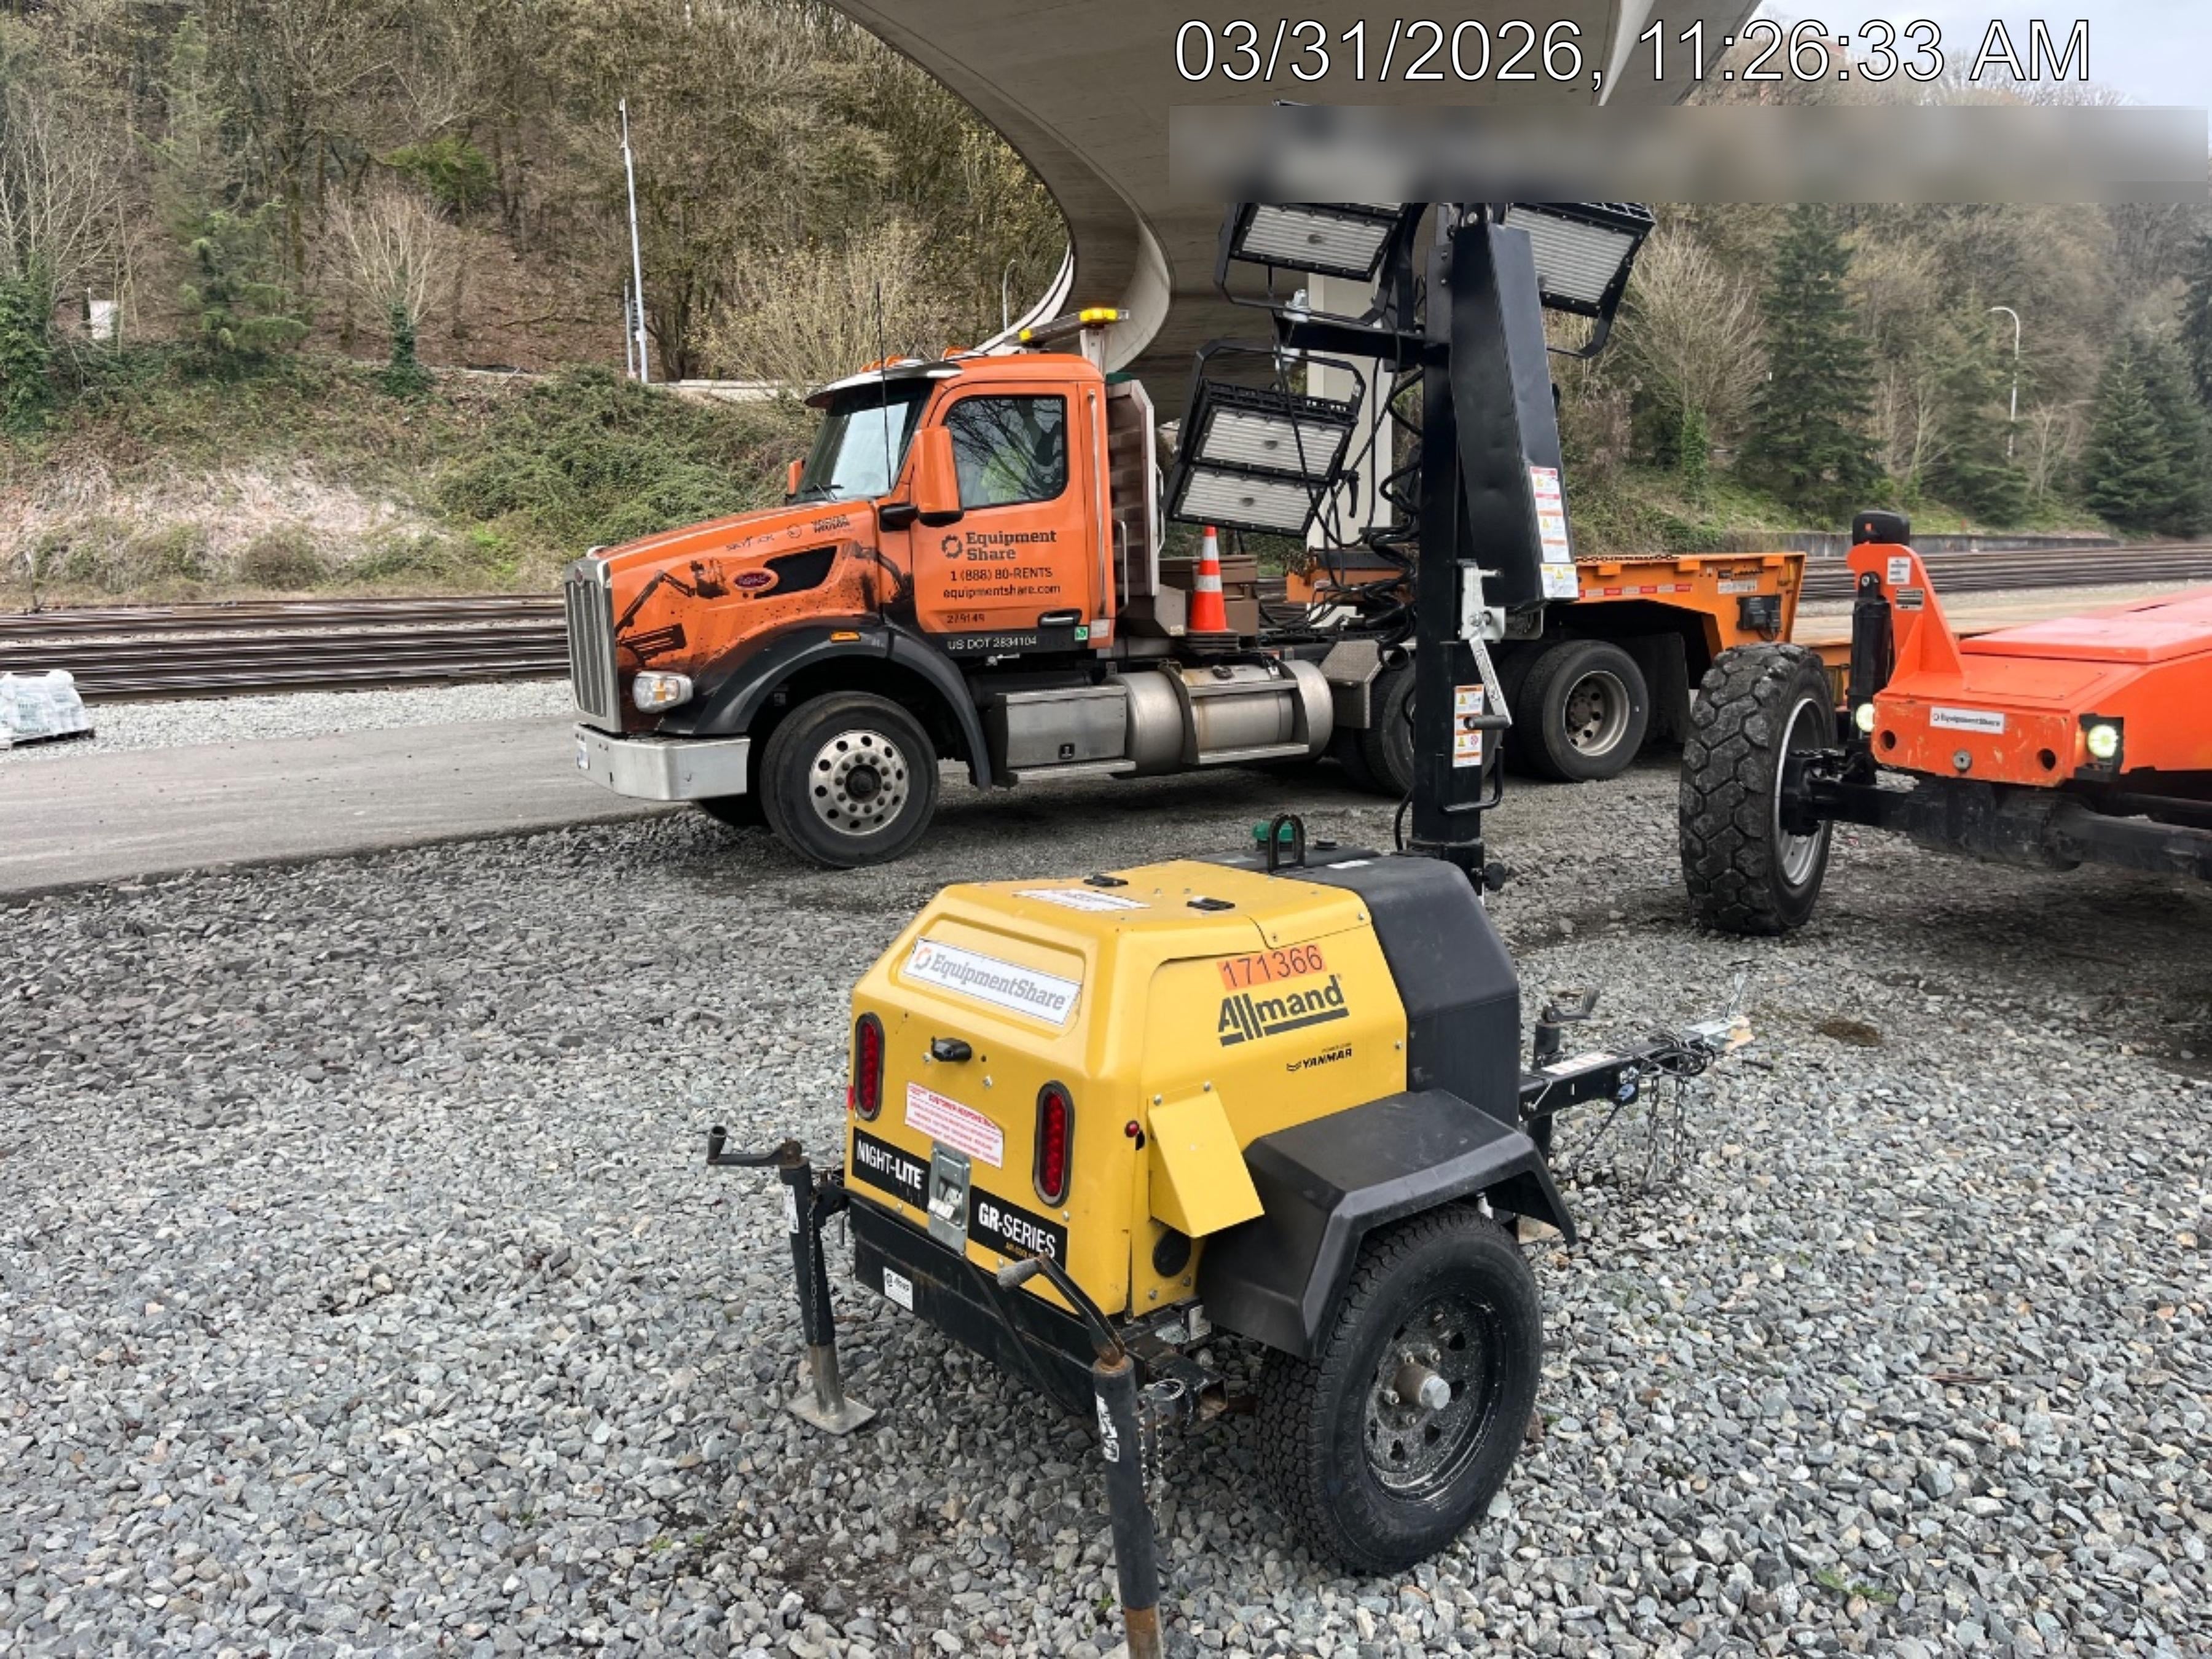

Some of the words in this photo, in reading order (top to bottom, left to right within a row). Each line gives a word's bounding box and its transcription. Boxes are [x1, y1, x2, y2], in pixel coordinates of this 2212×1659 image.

[966, 530, 1057, 547] Equipment
[967, 547, 1016, 561] Share
[951, 571, 957, 581] 1
[960, 569, 992, 581] (888)
[995, 567, 1053, 579] 80-RENTS
[943, 584, 1061, 600] equipmentshare.com
[947, 638, 965, 650] US
[967, 637, 991, 649] DOT
[1223, 944, 1322, 987] 171366
[931, 952, 1066, 1011] EquipmentShare
[1218, 975, 1344, 1041] Allmand
[1303, 1048, 1352, 1069] YANMAR
[857, 1139, 923, 1190] NIGHT-LITE
[978, 1202, 1056, 1259] GR-SERIES
